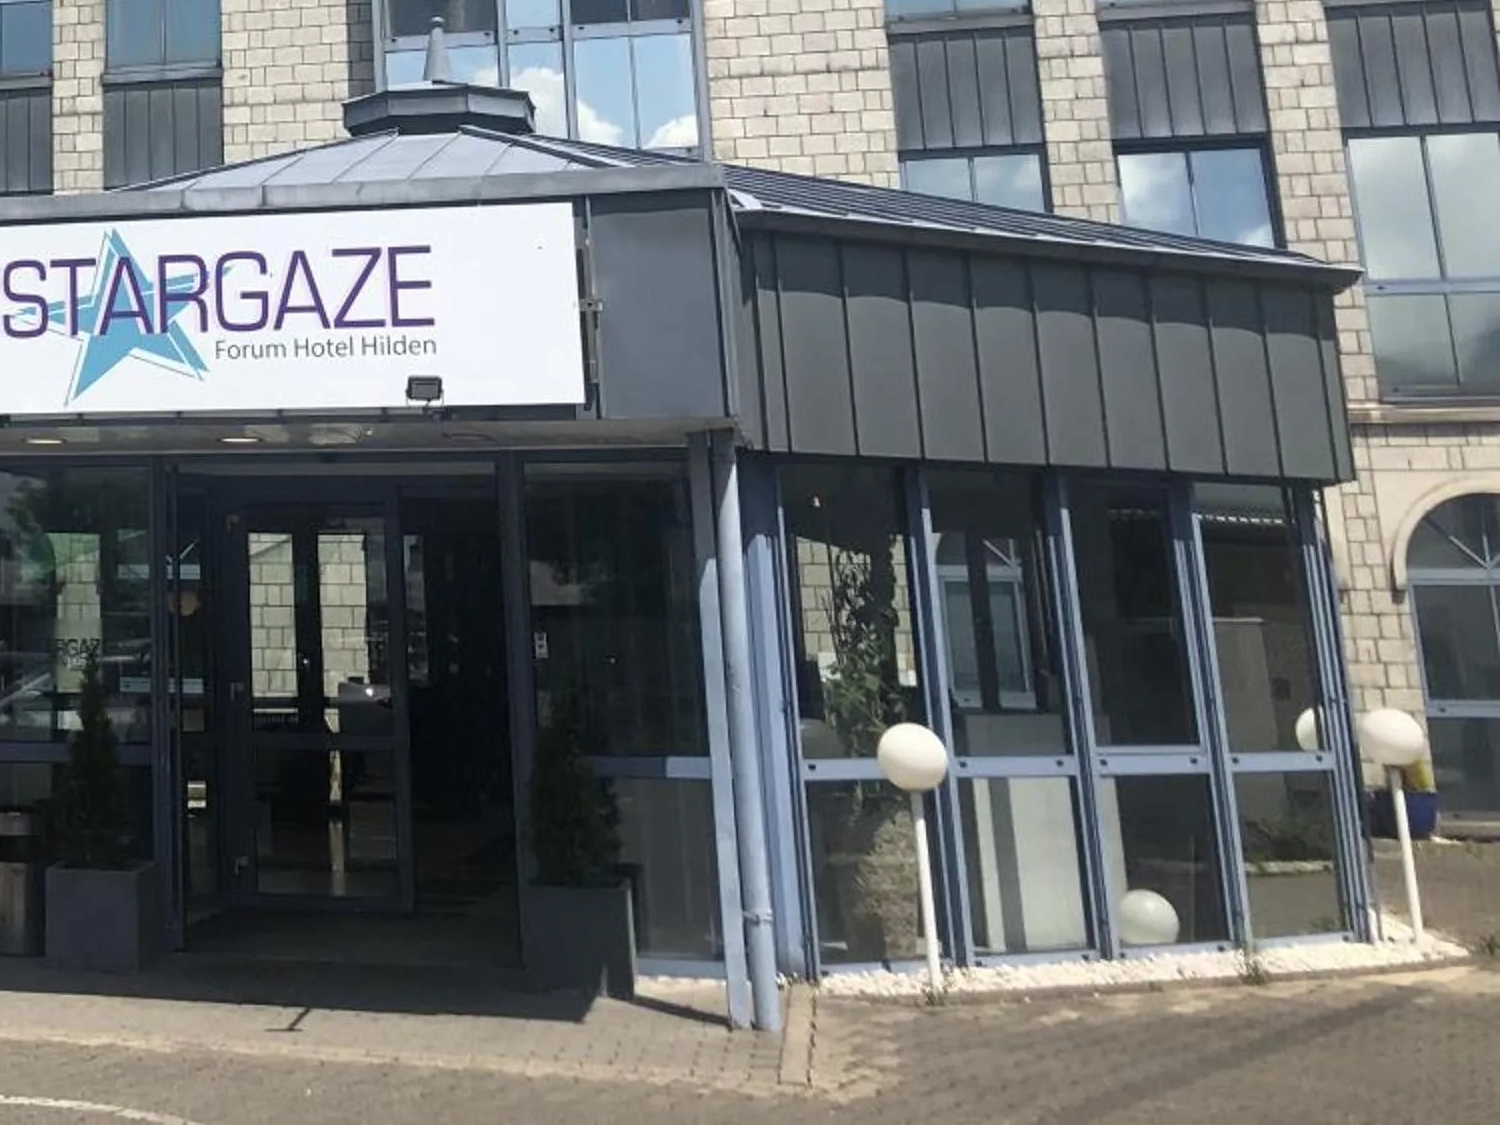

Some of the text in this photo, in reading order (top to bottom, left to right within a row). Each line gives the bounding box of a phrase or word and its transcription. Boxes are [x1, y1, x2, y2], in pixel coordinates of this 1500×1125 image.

[2, 245, 436, 339] STARGAZE
[214, 334, 437, 360] Forum Hotel Hilden
